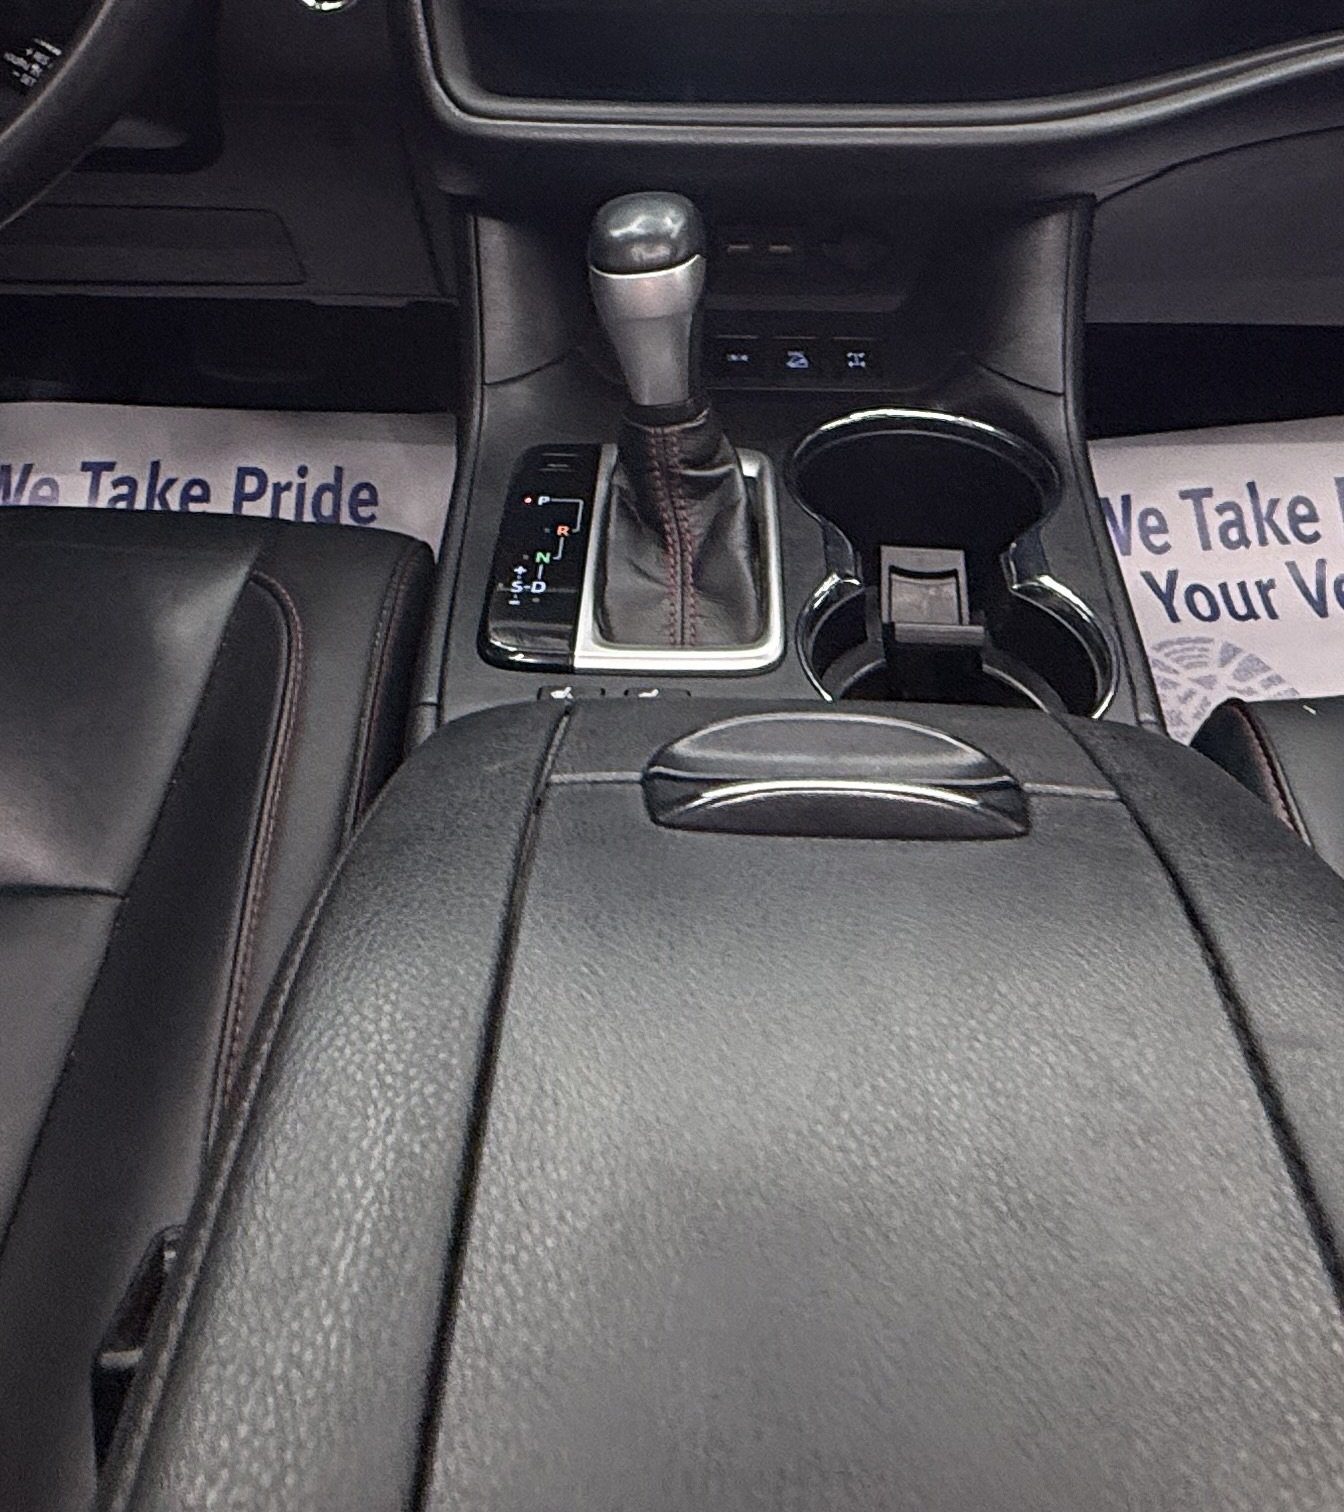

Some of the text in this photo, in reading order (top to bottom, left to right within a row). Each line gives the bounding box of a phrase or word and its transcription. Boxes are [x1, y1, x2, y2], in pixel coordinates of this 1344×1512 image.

[80, 459, 211, 512] Take
[235, 463, 380, 526] Pride
[538, 496, 550, 506] P
[557, 526, 570, 536] R
[1178, 480, 1321, 552] Take
[535, 552, 551, 563] N
[1140, 567, 1279, 623] Your
